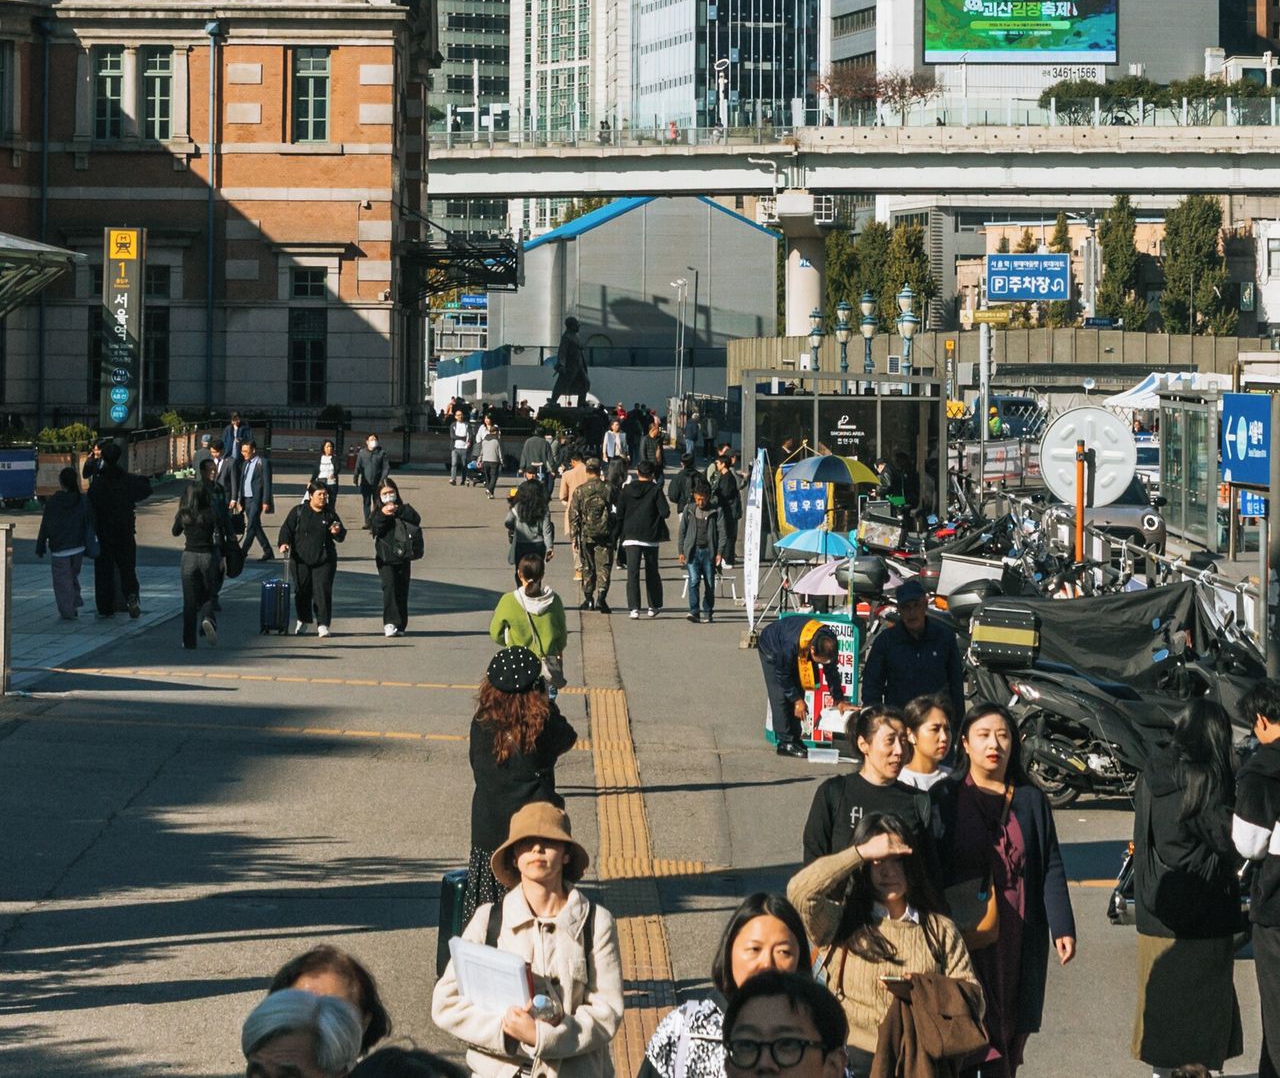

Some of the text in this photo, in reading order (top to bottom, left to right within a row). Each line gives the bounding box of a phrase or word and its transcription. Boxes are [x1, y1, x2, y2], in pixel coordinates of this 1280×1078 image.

[983, 1, 1071, 17] 괴산김장축제
[1052, 67, 1097, 79] 3461-1566
[118, 261, 127, 278] 1
[991, 260, 1010, 268] 서울역
[994, 276, 1050, 294] P 주차장
[114, 293, 129, 341] 서울역
[1248, 420, 1264, 445] 서울역
